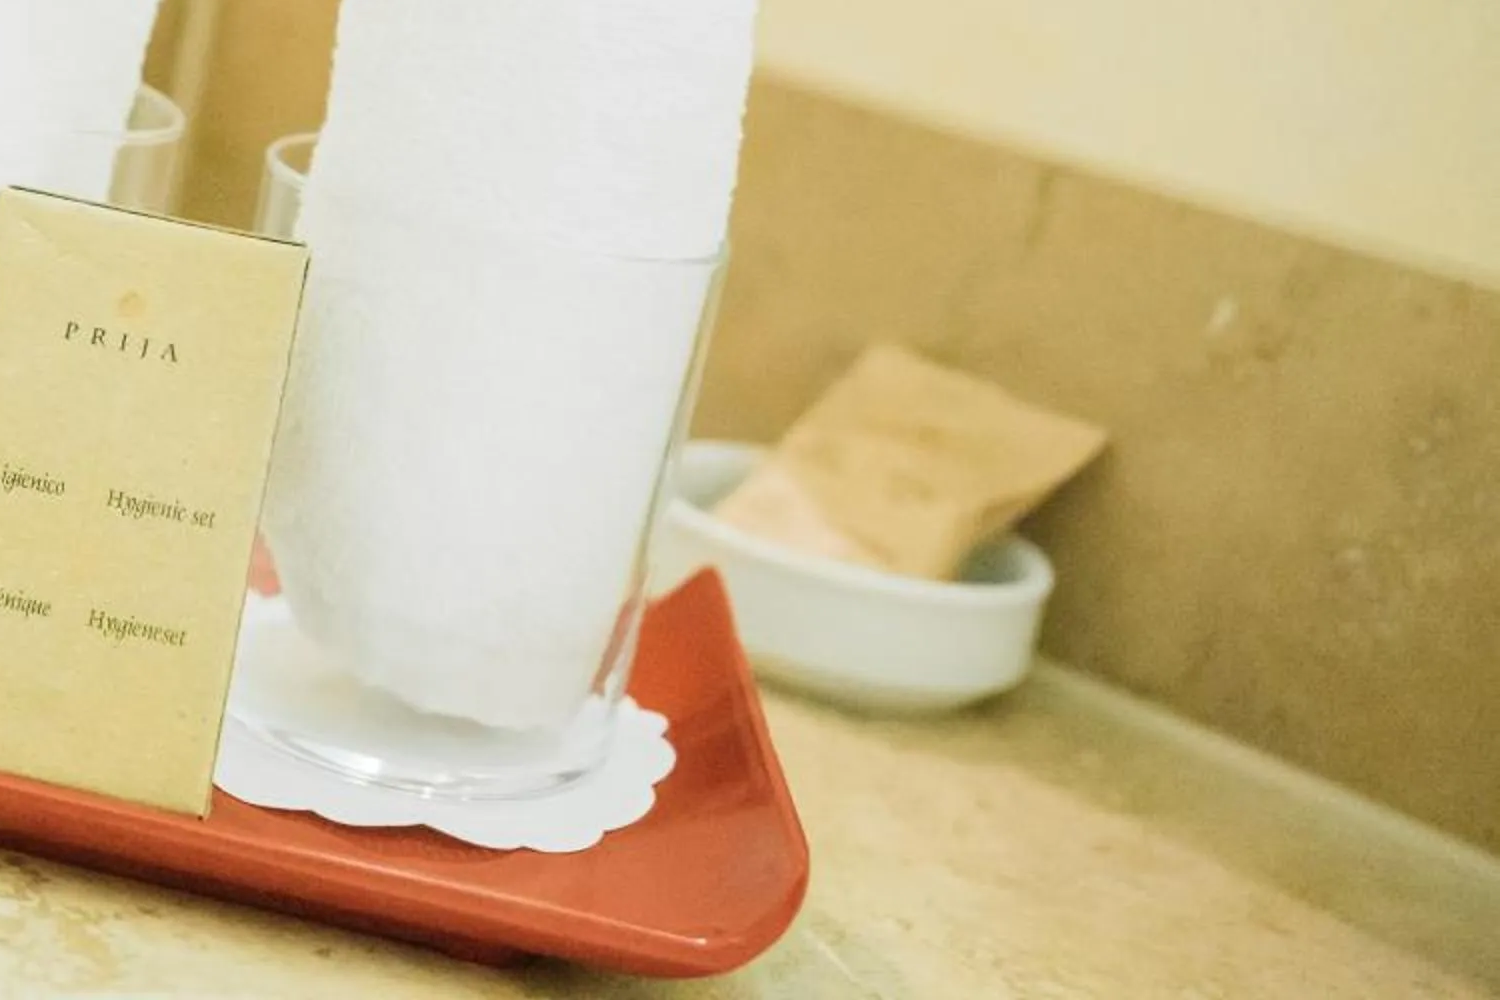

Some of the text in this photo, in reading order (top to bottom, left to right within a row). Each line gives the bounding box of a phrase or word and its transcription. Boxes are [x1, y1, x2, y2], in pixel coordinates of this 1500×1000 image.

[64, 321, 180, 363] PRIJA
[0, 462, 66, 498] igienico
[106, 487, 216, 529] Hygienic set
[87, 607, 188, 648] Hygieneset
